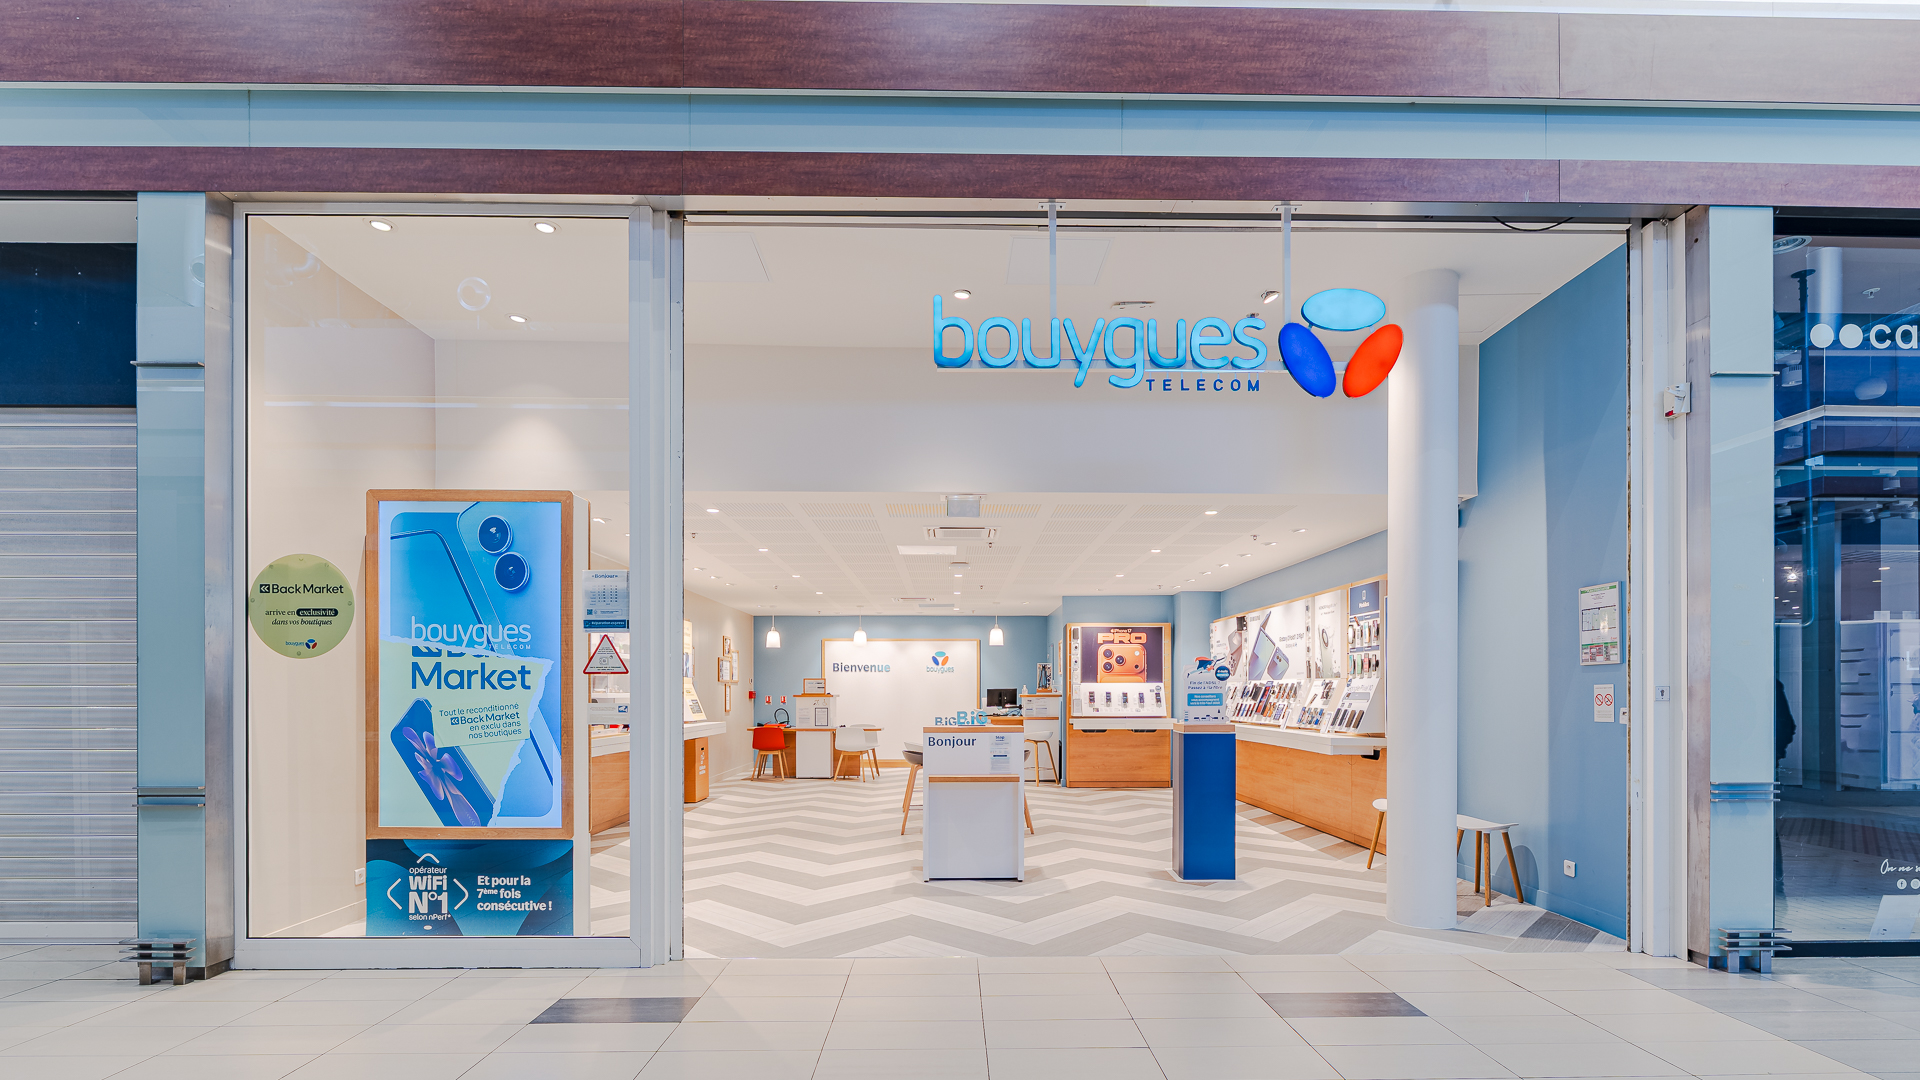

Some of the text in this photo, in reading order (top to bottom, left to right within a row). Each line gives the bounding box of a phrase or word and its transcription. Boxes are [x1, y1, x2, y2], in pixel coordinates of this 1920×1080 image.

[933, 294, 1268, 390] bouygues
[1145, 378, 1261, 392] TELECOM
[271, 584, 344, 594] Back Market
[271, 618, 289, 626] dans
[300, 618, 333, 627] boutiques
[411, 615, 532, 650] bouygues
[1097, 632, 1147, 644] PRO
[832, 662, 891, 673] Bienvenue
[926, 665, 955, 674] bouygues
[411, 661, 531, 690] Market
[439, 702, 519, 717] Tout le reconditionné
[460, 711, 520, 725] Back Market
[480, 722, 501, 731] exclu
[502, 719, 522, 729] dans
[483, 728, 523, 738] boutiques
[928, 735, 977, 749] Bonjour
[408, 866, 448, 874] opérateur
[1880, 858, 1896, 875] On
[408, 875, 448, 891] WiFi
[477, 875, 531, 888] Et pour la
[476, 888, 521, 899] 7ème fois
[408, 891, 449, 914] N°1
[476, 900, 553, 911] consécutive !
[408, 913, 428, 921] selon
